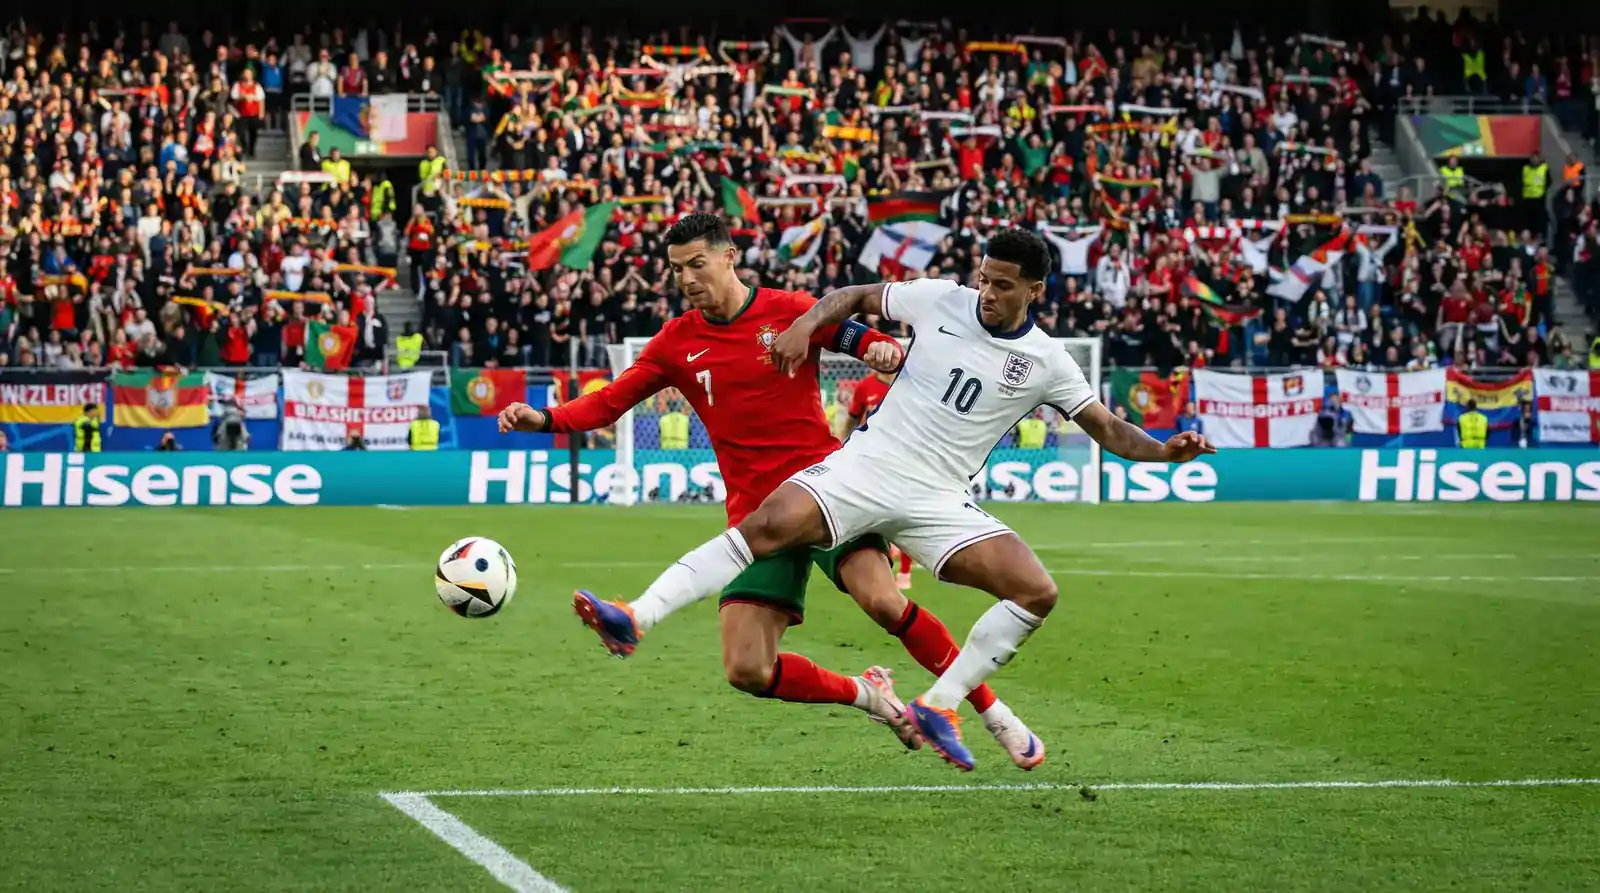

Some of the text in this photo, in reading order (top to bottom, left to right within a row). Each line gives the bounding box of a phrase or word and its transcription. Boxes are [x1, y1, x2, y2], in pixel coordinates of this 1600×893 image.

[695, 369, 714, 407] 7
[941, 367, 983, 416] 10
[4, 453, 323, 506] Hisense
[468, 450, 728, 503] Hisens
[970, 459, 1218, 502] sense
